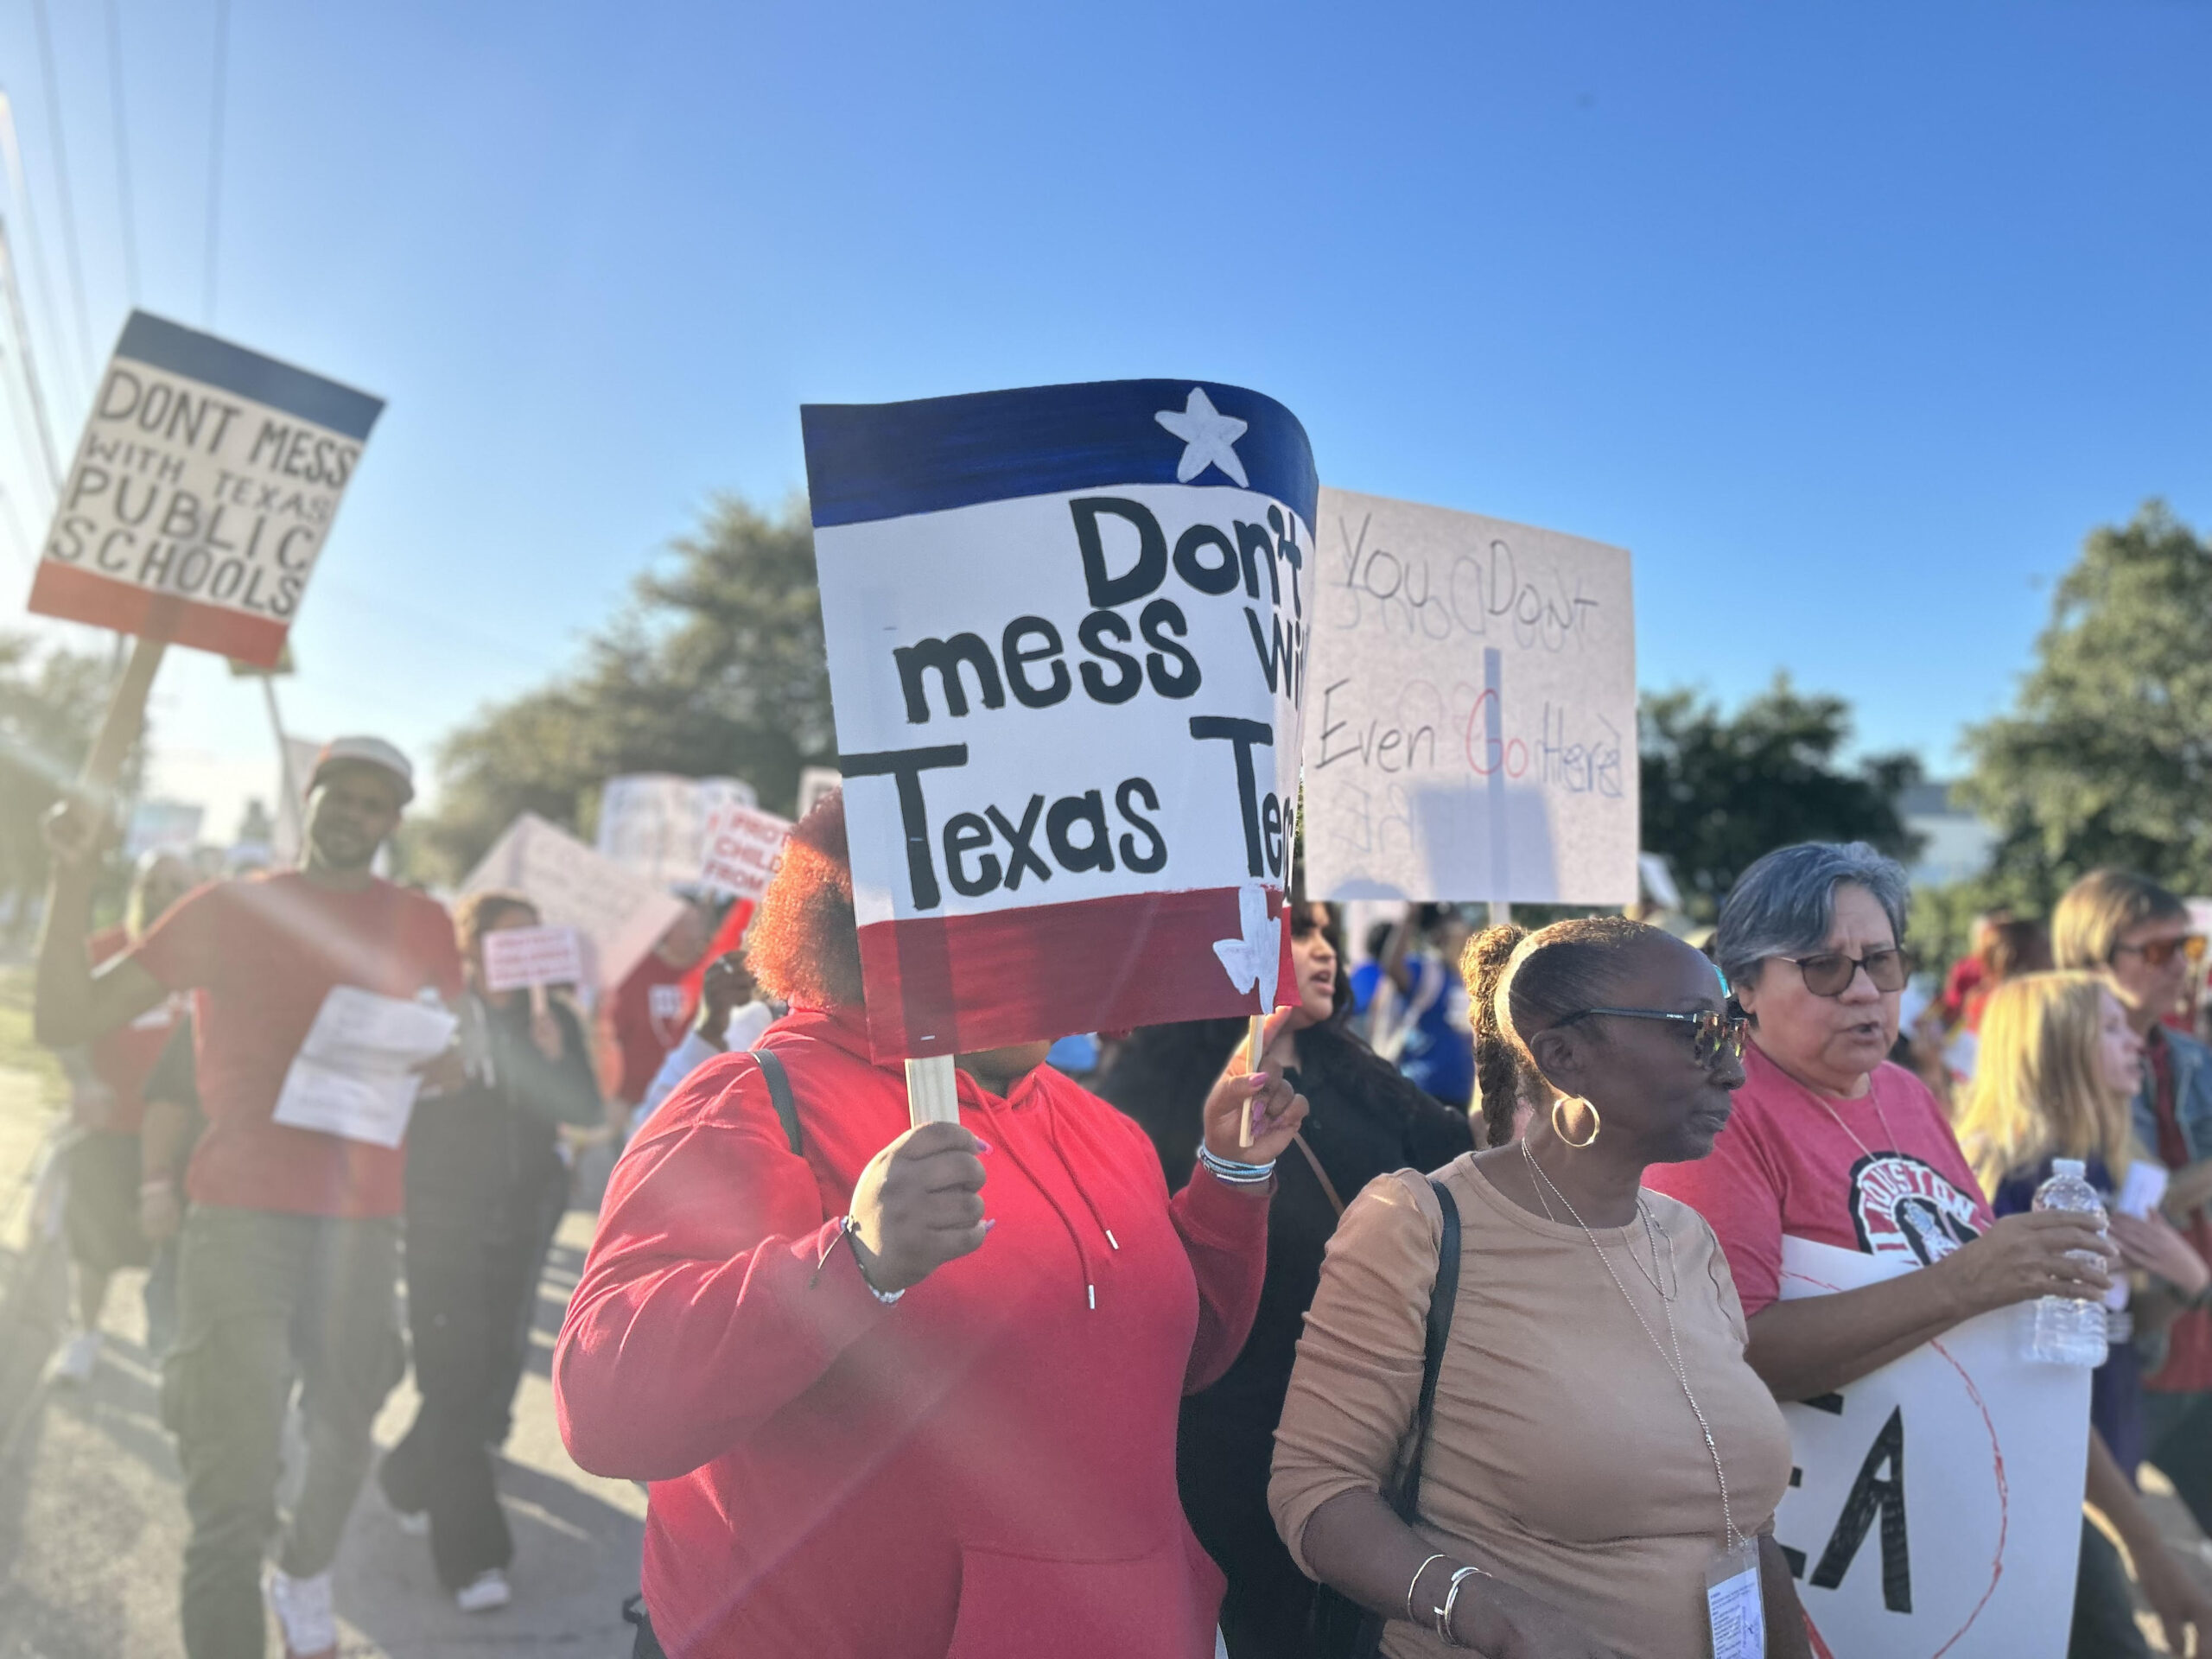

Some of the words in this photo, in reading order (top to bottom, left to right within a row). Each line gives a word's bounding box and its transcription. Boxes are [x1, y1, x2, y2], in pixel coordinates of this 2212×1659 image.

[86, 434, 186, 484] WITH
[214, 469, 334, 525] TEXAS
[97, 368, 243, 455] DONT
[248, 417, 359, 491] MESS
[52, 516, 302, 618] SCHOOLS
[67, 466, 315, 575] PUBLIC
[1070, 497, 1302, 620] Don't
[1338, 512, 1430, 608] You
[893, 598, 1203, 724] mess
[1314, 677, 1435, 772] Even
[1465, 688, 1529, 779] Go
[838, 742, 1168, 912] Texas
[1777, 1392, 1913, 1615] A
